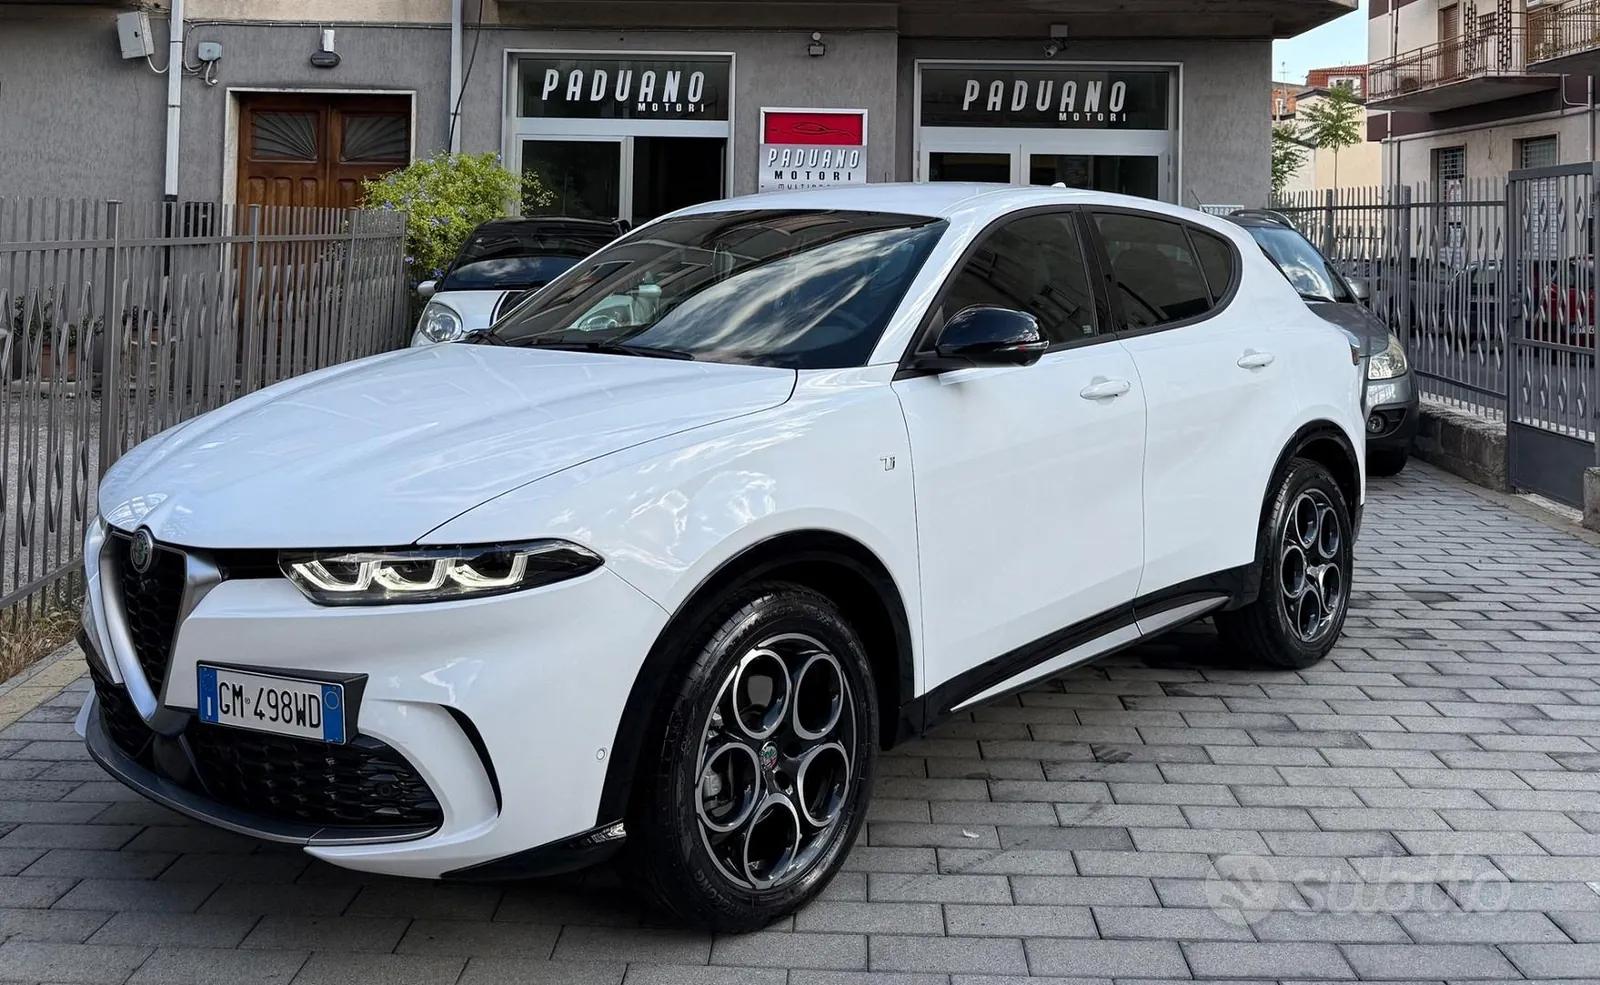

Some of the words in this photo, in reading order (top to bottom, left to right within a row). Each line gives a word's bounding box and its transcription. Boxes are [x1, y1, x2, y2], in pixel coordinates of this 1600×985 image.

[541, 68, 705, 102] PADUANO
[962, 79, 1127, 112] PADUANO
[637, 102, 705, 113] MOTORI
[1058, 112, 1127, 122] MOTORI
[768, 148, 861, 168] PADUANO
[774, 170, 852, 181] MOTORI
[218, 681, 245, 718] GM
[253, 687, 322, 729] 498WD
